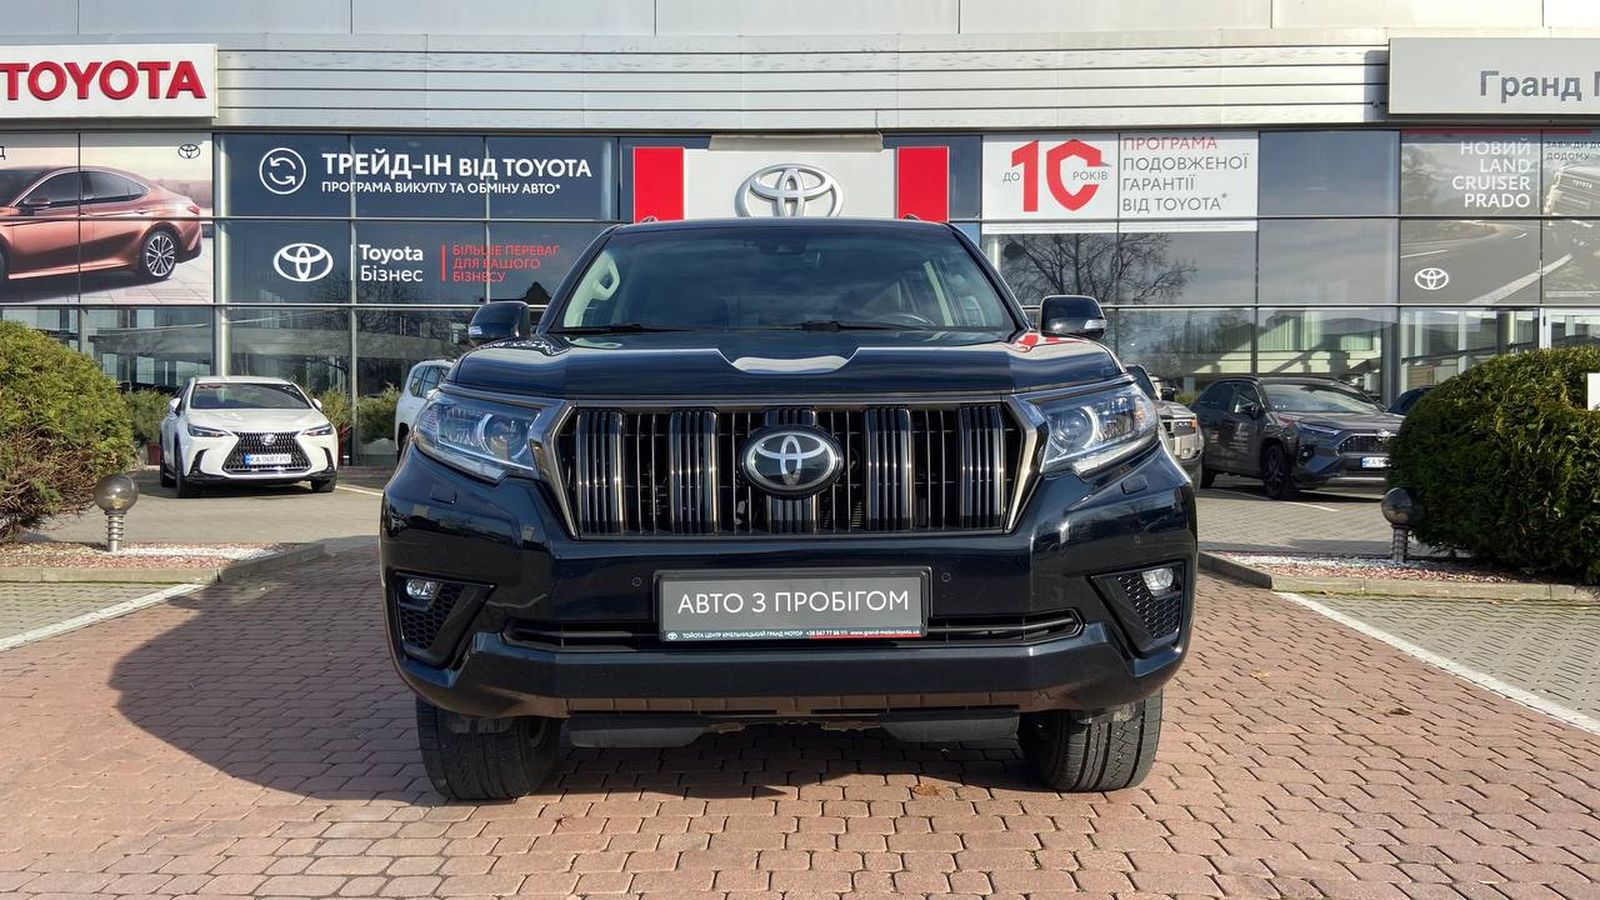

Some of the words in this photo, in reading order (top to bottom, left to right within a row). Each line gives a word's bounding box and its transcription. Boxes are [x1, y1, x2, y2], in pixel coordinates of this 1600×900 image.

[0, 60, 207, 101] TOYOTA
[1480, 70, 1582, 104] Гранд
[1123, 136, 1217, 151] ПРОГРАМА
[1460, 137, 1531, 155] НОВИЙ
[1123, 153, 1249, 173] ПОДОВЖЕНОЇ
[1546, 151, 1589, 160] ДОДОМУ
[322, 148, 451, 180] ТРЕЙД-ІН
[459, 158, 498, 180] ВІД
[502, 158, 592, 177] TOYOTA
[1480, 159, 1531, 173] LAND
[1003, 172, 1021, 183] ДО
[1072, 170, 1108, 181] РОКІВ
[1123, 174, 1194, 191] ГАРАНТІЇ
[1452, 176, 1531, 191] CRUISER
[322, 181, 392, 193] ПРОГРАМА
[395, 182, 447, 193] ВИКУПУ
[449, 182, 465, 193] ТА
[467, 183, 519, 194] ОБМІНУ
[1122, 198, 1149, 214] ВІД
[1464, 193, 1531, 208] PRADO
[359, 244, 424, 264] Toyota
[452, 244, 501, 256] БІЛЬШЕ
[505, 244, 560, 256] ПЕРЕВАГ
[453, 258, 480, 270] ДЛЯ
[360, 265, 423, 282] Бізнес
[453, 271, 506, 282] БІЗНЕСУ
[677, 592, 744, 614] АВТО
[751, 592, 766, 613] З
[775, 590, 909, 613] ПРОБІГОМ
